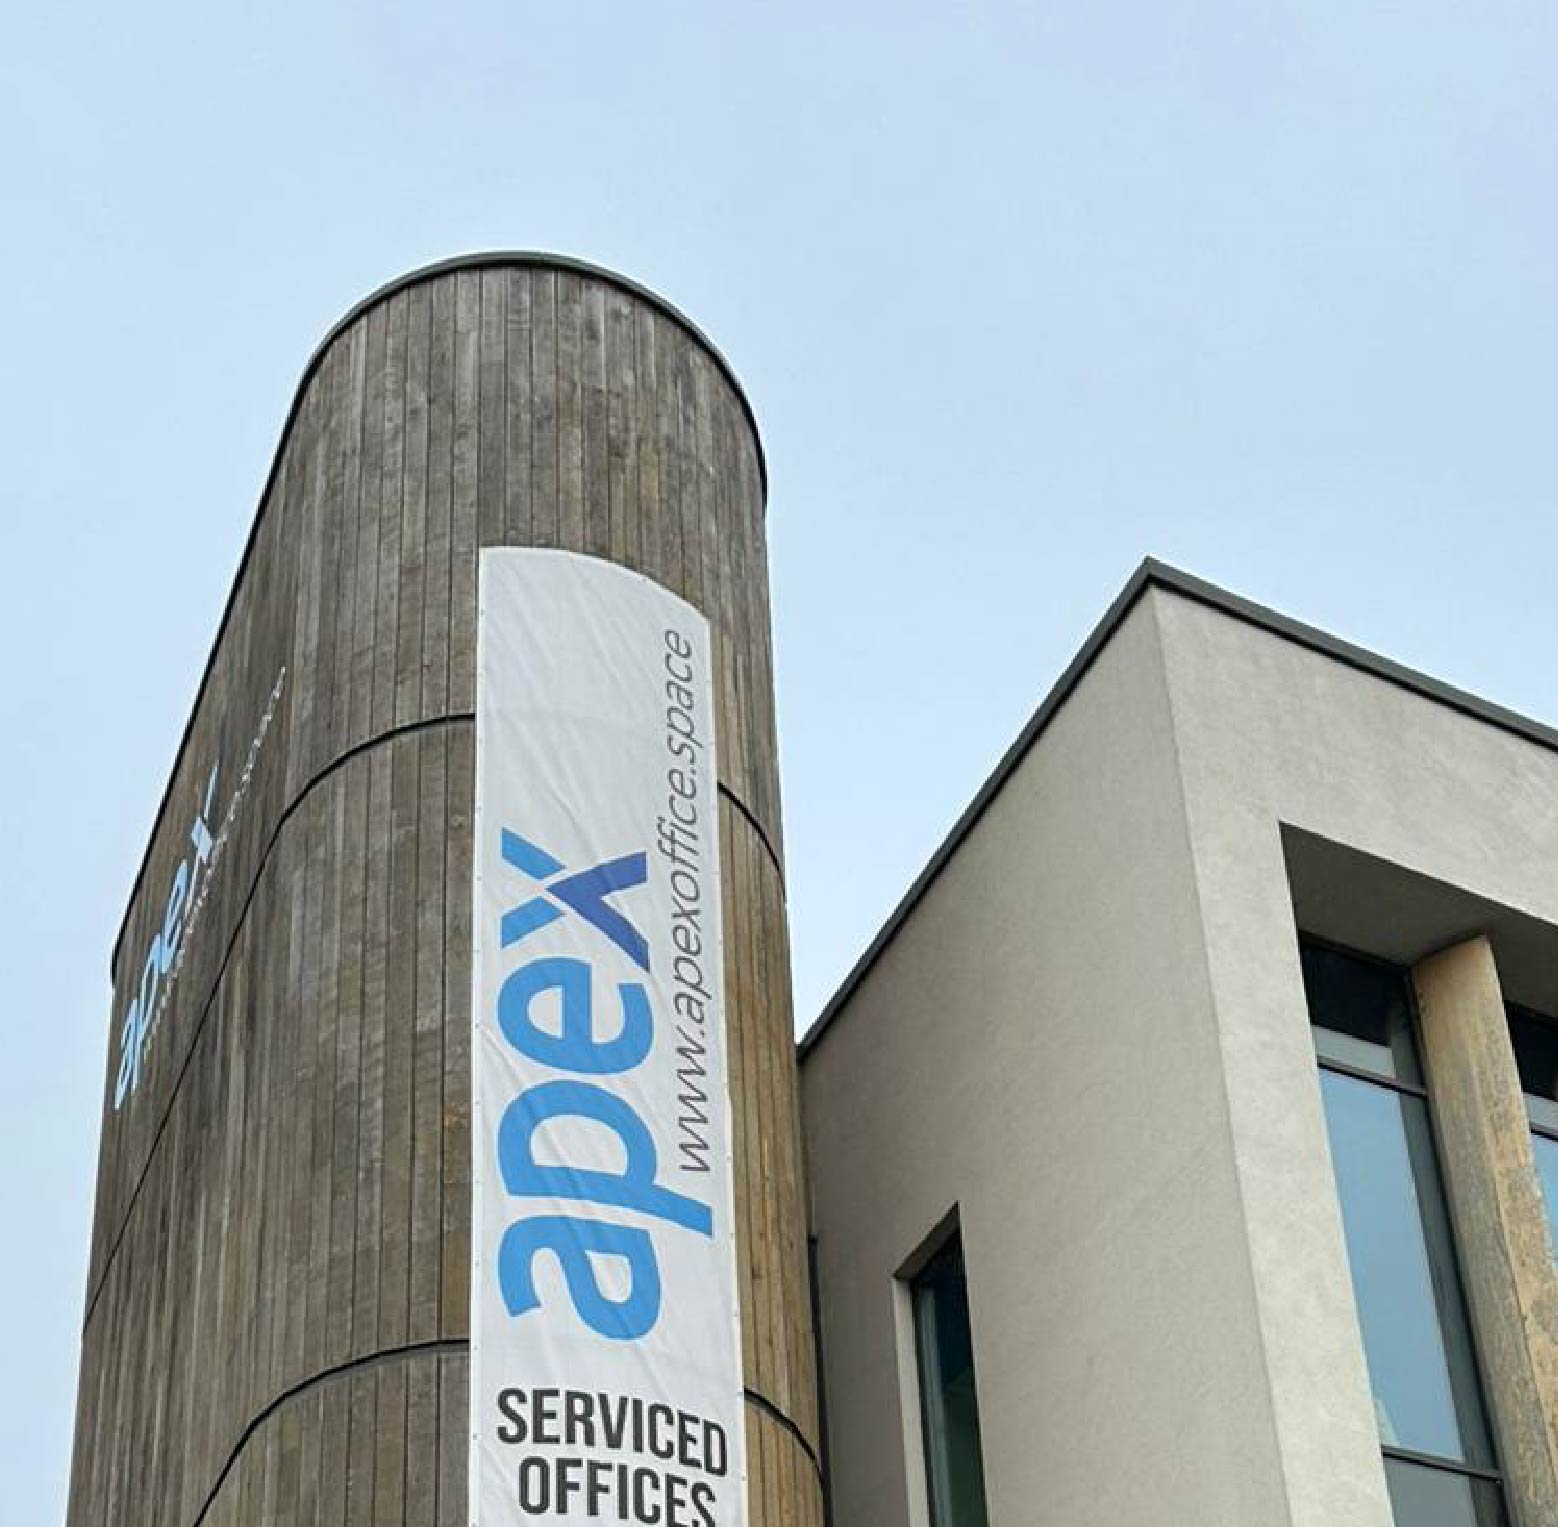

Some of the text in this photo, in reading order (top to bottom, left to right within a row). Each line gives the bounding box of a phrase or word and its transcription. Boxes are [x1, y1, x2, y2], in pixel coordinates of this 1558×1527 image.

[496, 826, 713, 1341] apex
[656, 629, 712, 1174] www.apexoffice.space
[497, 1387, 727, 1477] SERVICED
